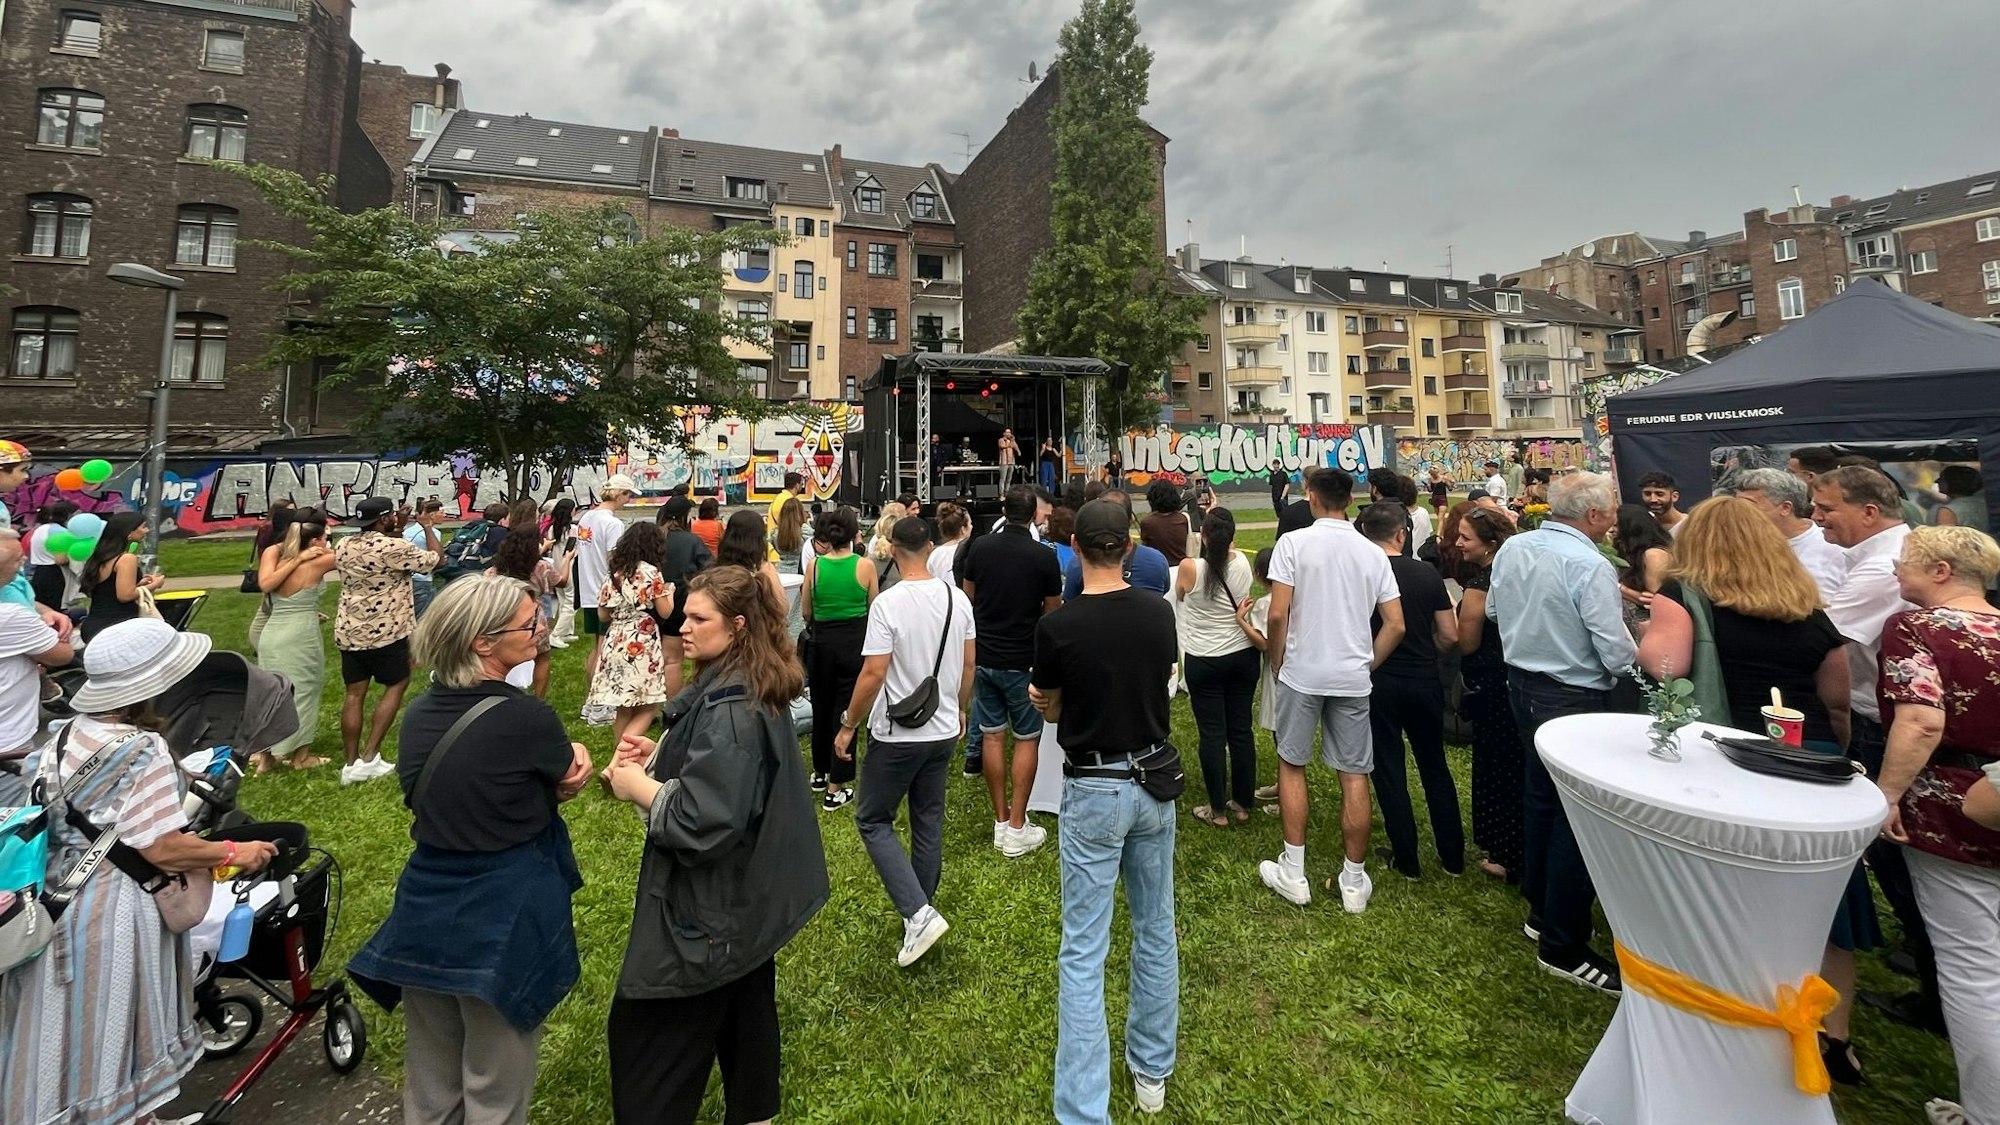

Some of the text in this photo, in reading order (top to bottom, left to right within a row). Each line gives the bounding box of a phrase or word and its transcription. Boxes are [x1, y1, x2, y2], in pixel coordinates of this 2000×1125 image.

[1626, 406, 1784, 425] FERUDNE EDR VIUSLKMOSK
[78, 757, 100, 775] FILA
[78, 849, 102, 874] FILA
